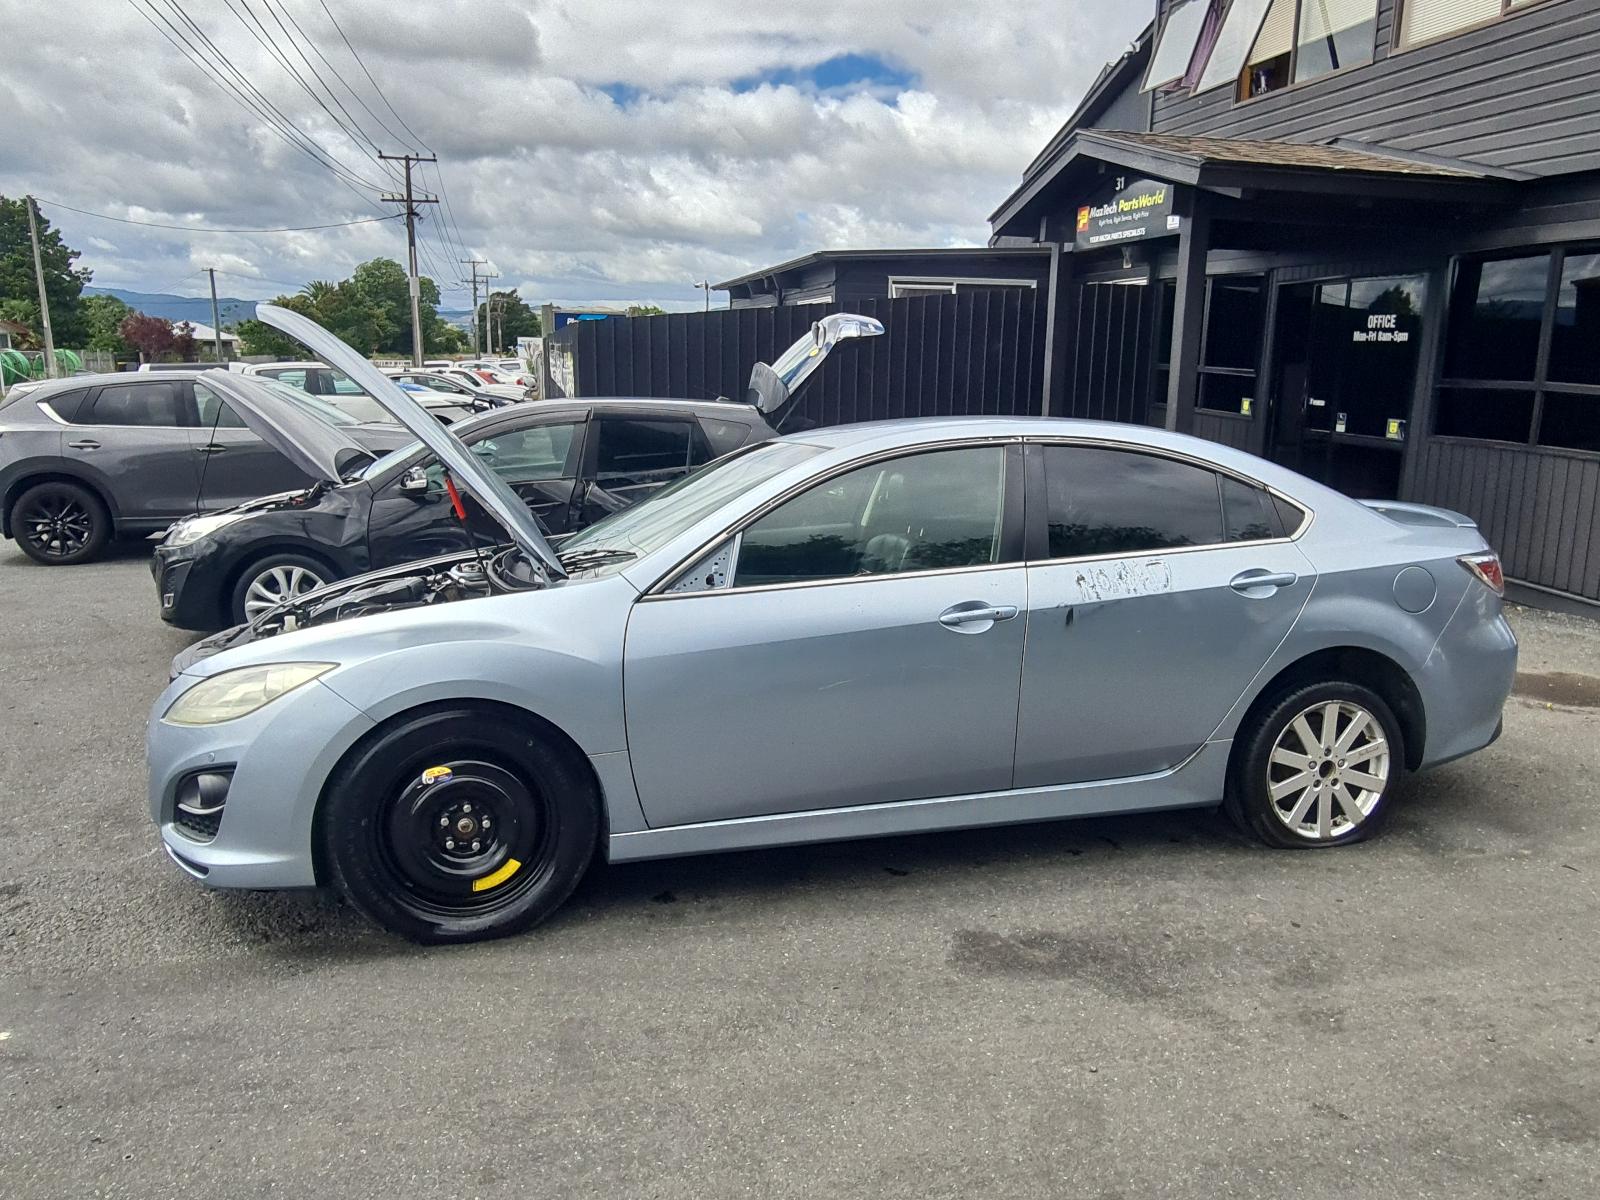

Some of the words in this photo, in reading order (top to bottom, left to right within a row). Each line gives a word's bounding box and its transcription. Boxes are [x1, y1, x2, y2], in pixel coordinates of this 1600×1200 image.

[1116, 176, 1125, 190] 31
[1118, 189, 1165, 212] PartsWorld
[1367, 314, 1397, 329] OFFICE
[1353, 330, 1377, 342] Mon-Fri
